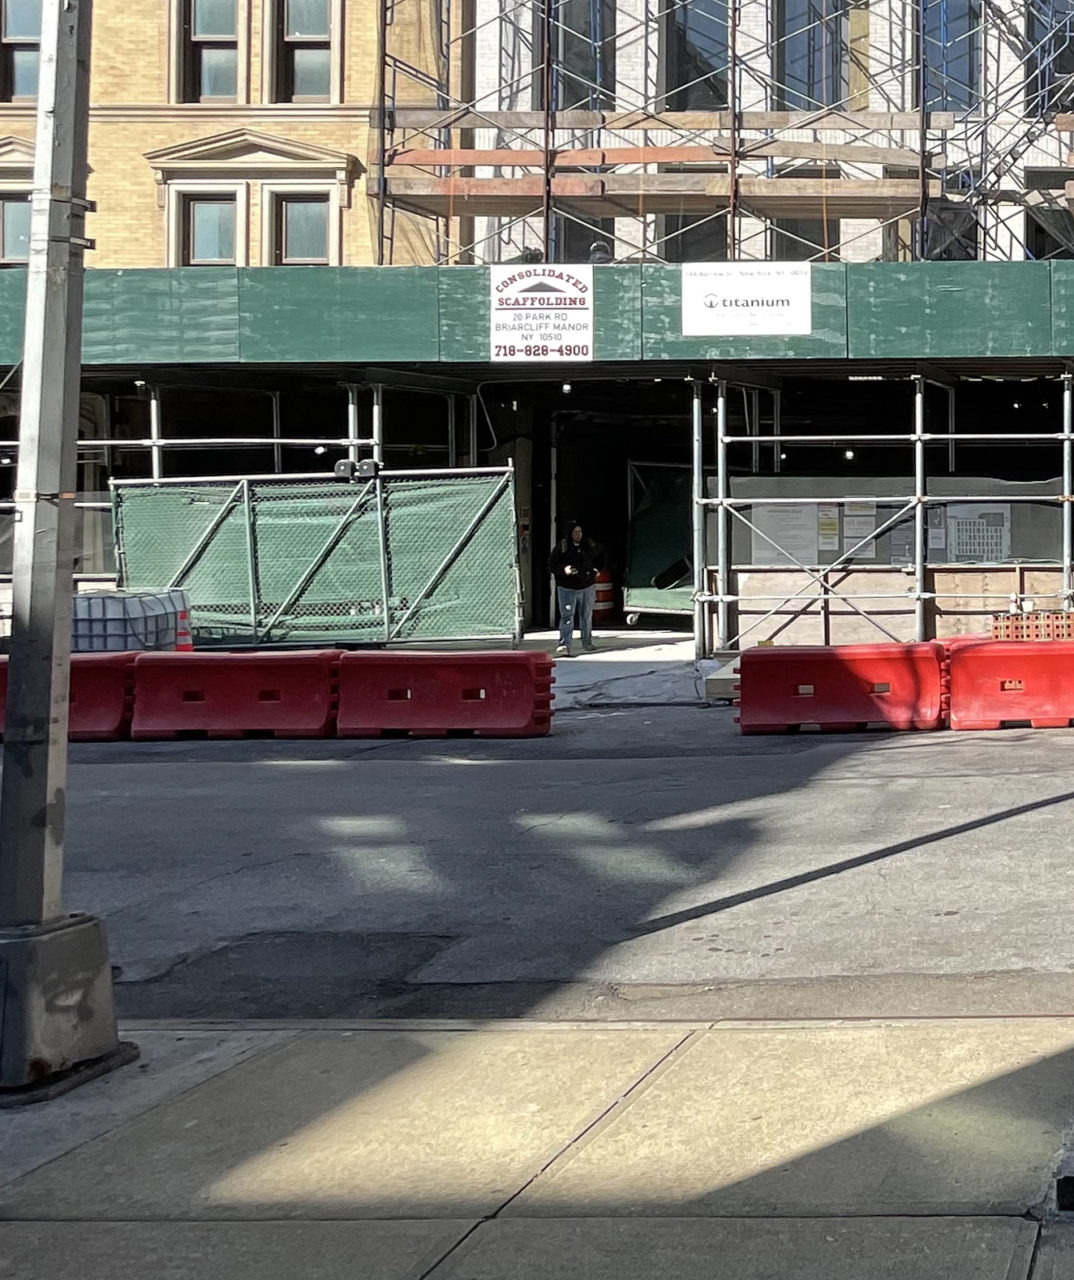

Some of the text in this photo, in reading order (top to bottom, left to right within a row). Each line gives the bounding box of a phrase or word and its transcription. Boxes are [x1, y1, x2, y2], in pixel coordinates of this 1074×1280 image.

[495, 268, 589, 294] CONSOLIDATED
[498, 297, 586, 306] SCAFFOLDING
[722, 297, 791, 307] titanium
[513, 313, 568, 321] 20 PARK RD
[495, 323, 589, 331] BRIARCLIFF MANOR
[521, 333, 562, 341] NY 10510
[495, 345, 589, 357] 718-828-4900
